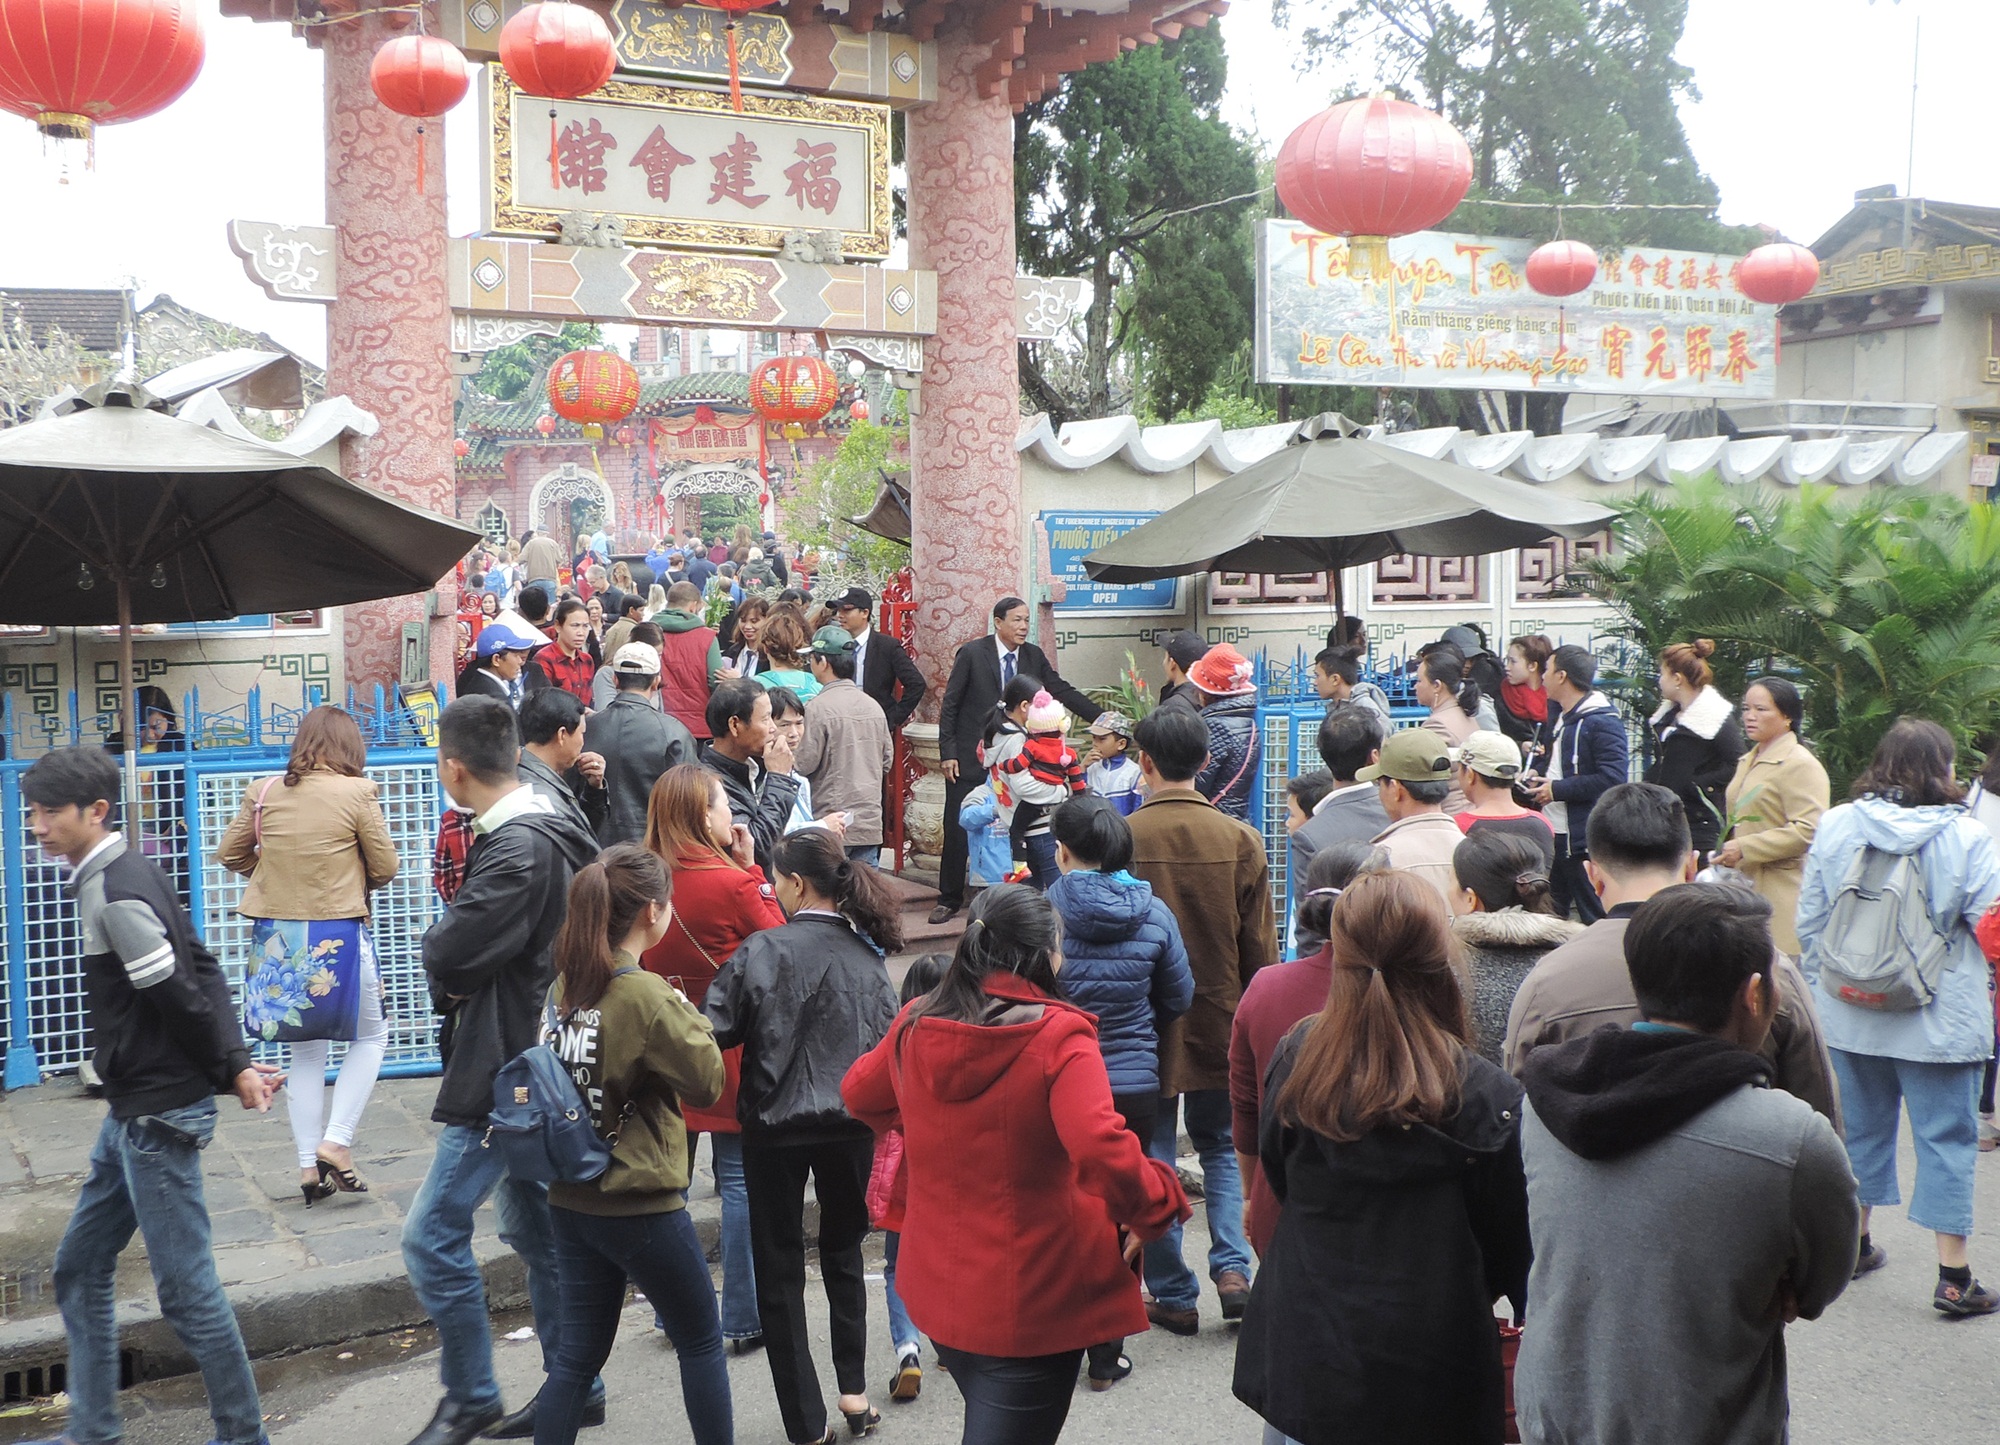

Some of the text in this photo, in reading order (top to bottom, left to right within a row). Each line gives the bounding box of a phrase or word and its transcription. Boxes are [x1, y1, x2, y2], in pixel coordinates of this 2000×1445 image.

[1740, 299, 1754, 315] An
[1435, 312, 1472, 331] tháng
[1477, 314, 1511, 333] giêng
[1516, 315, 1546, 334] hàng
[1092, 592, 1118, 604] OPEN
